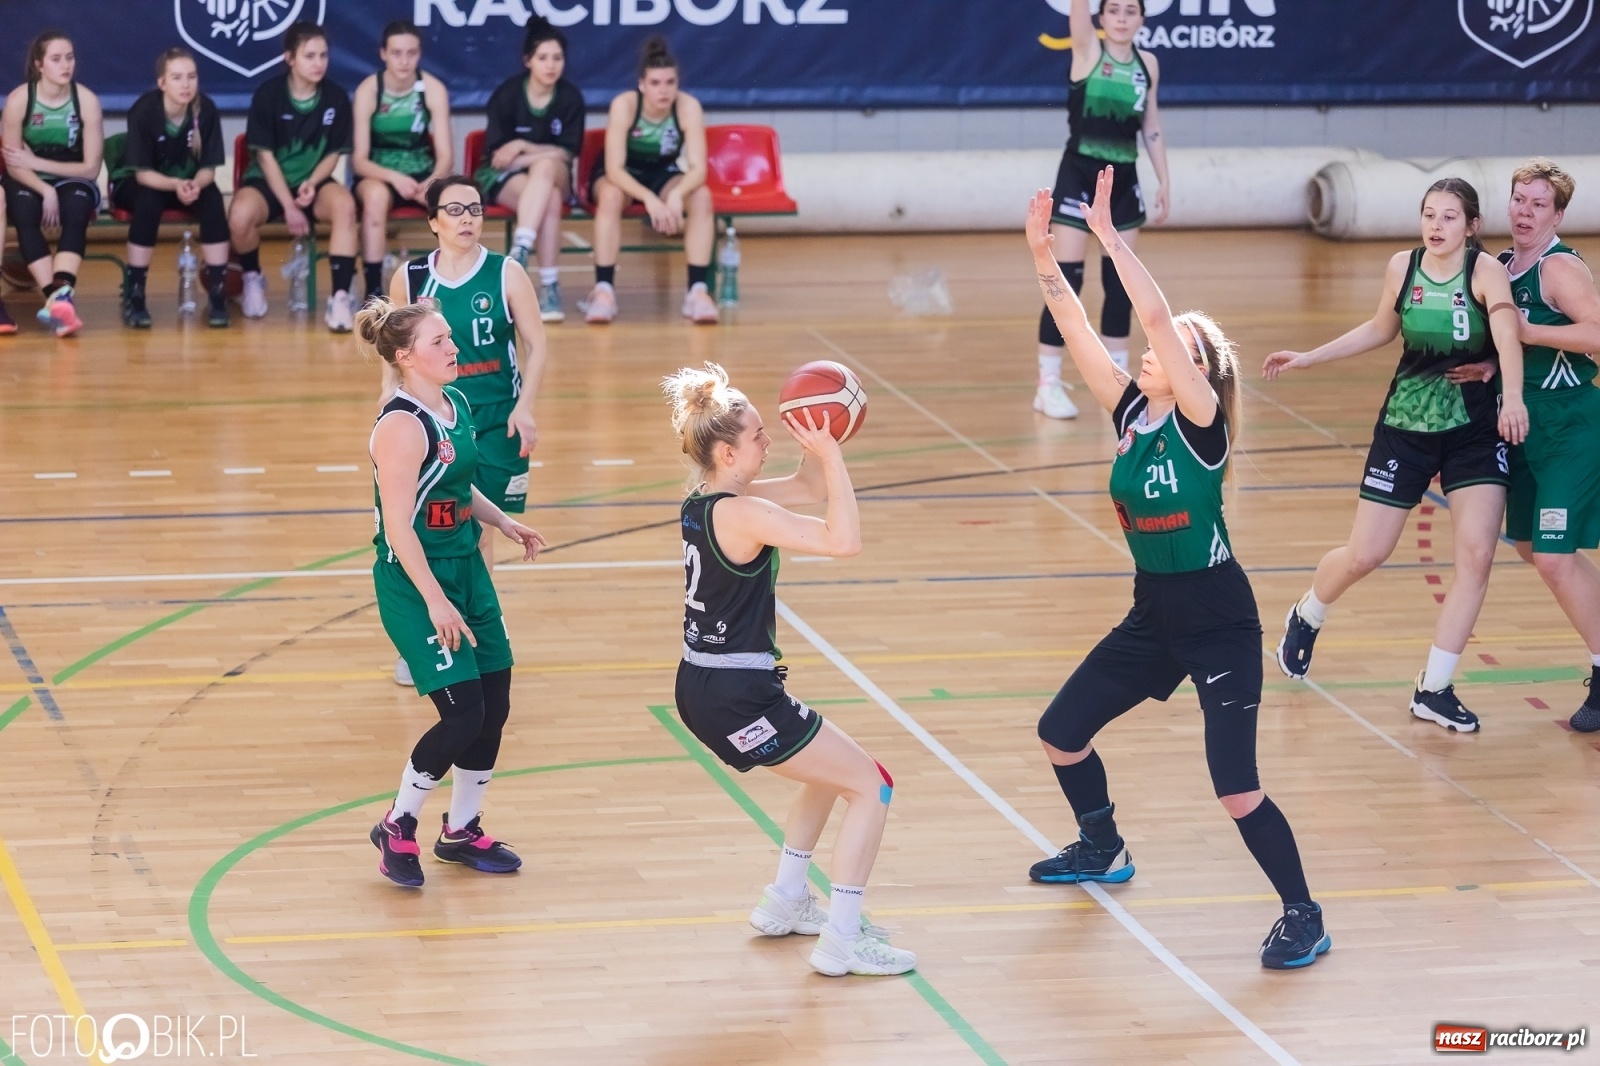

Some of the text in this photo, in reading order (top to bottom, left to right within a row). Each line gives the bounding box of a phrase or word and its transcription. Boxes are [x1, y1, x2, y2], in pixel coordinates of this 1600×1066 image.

[1133, 86, 1147, 112] 2
[472, 317, 495, 346] 13
[1452, 310, 1470, 341] 9
[1144, 459, 1178, 499] 24
[429, 503, 455, 526] K
[1136, 511, 1191, 531] KAMAN
[427, 634, 453, 671] 3
[749, 738, 780, 760] LUCY
